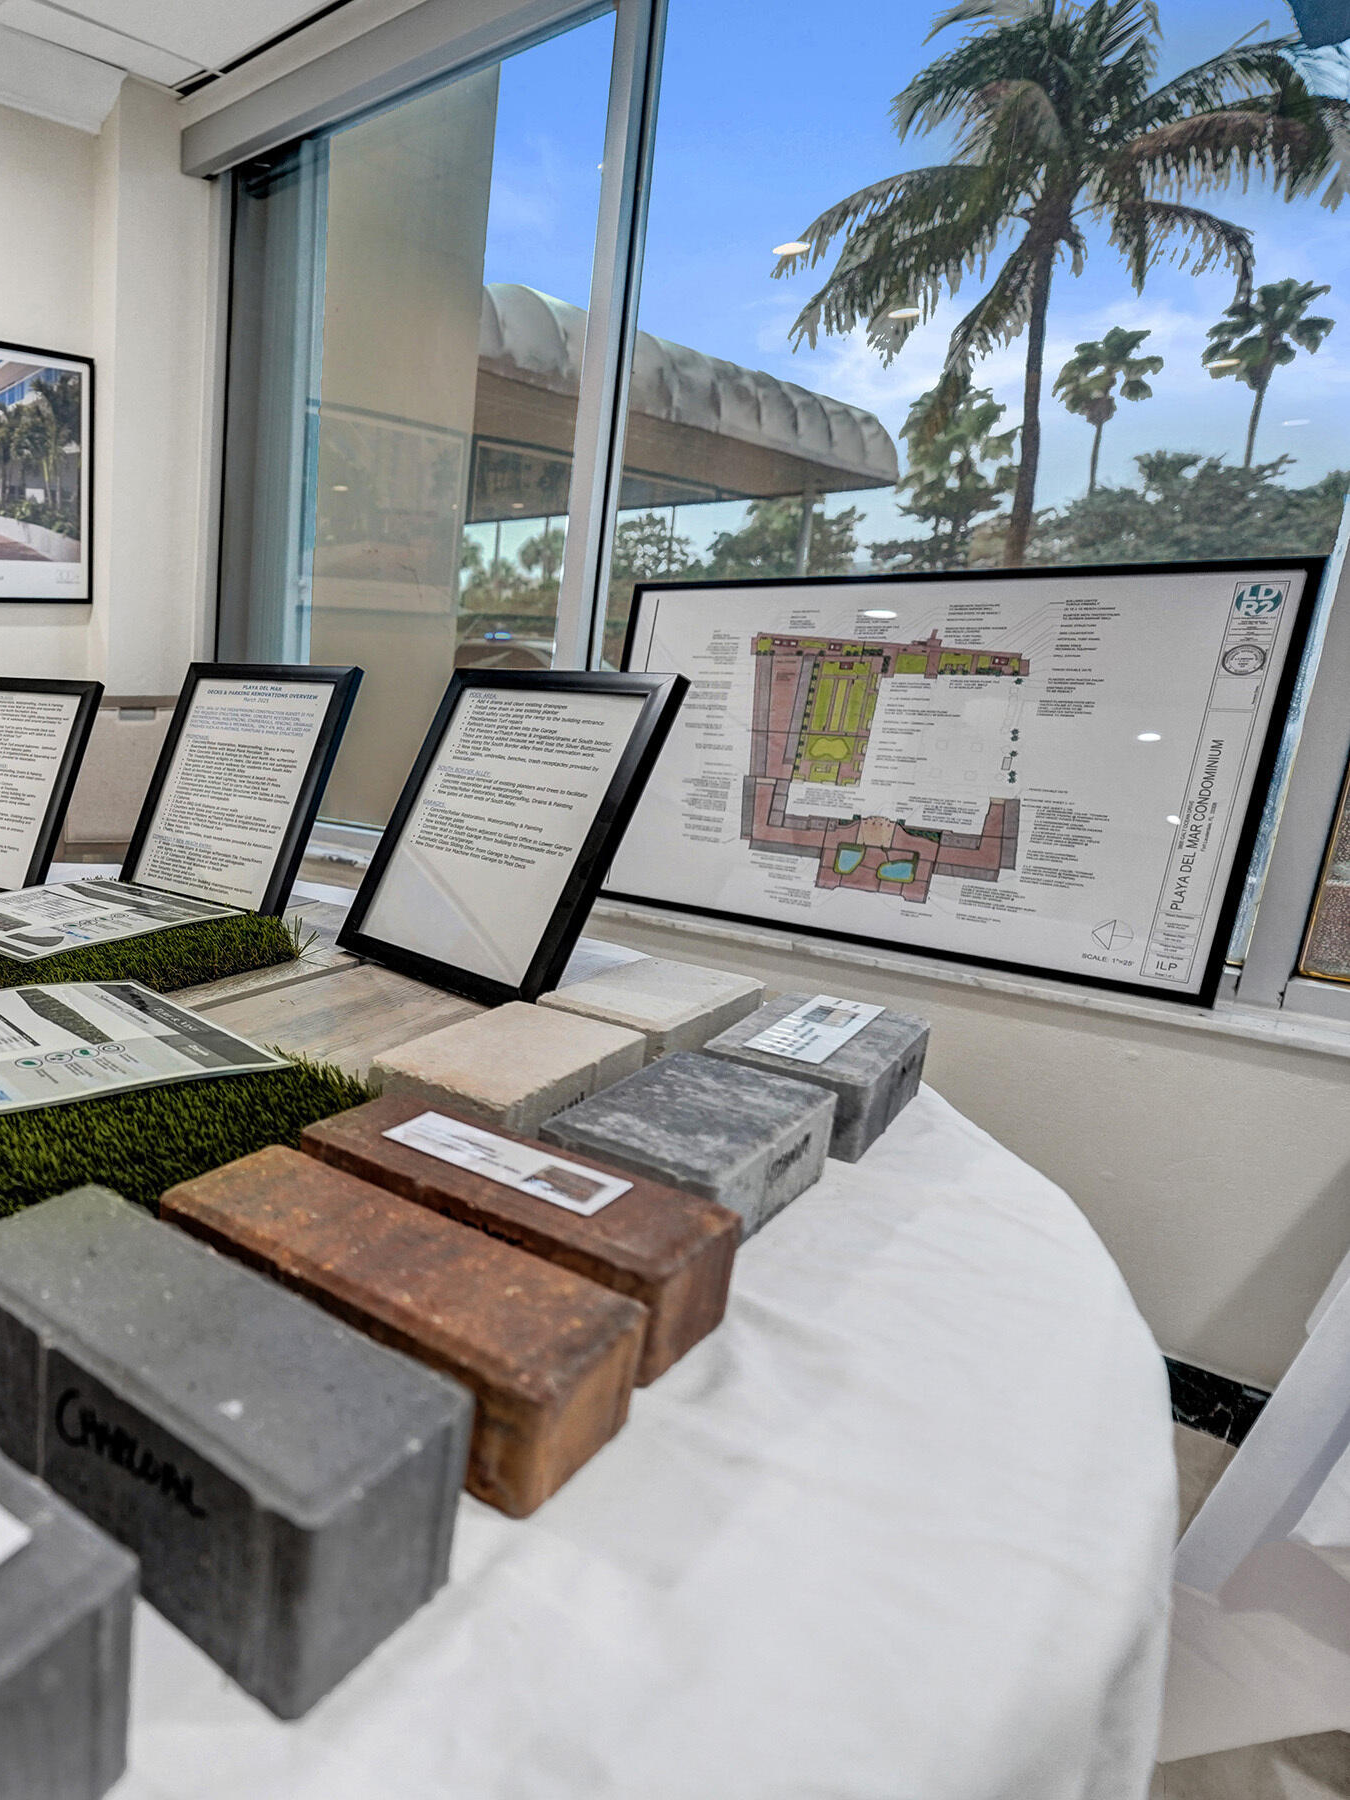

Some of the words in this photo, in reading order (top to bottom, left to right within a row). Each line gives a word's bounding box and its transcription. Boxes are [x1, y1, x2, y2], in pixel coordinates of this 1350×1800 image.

[1195, 739, 1224, 822] CONDOMINIUM
[553, 801, 574, 809] Painting
[1186, 824, 1202, 848] MAR
[487, 849, 503, 857] Garage
[554, 843, 573, 851] Garage
[1180, 851, 1196, 872] DEL
[1170, 874, 1190, 910] PLAYA
[1156, 961, 1178, 971] ILP
